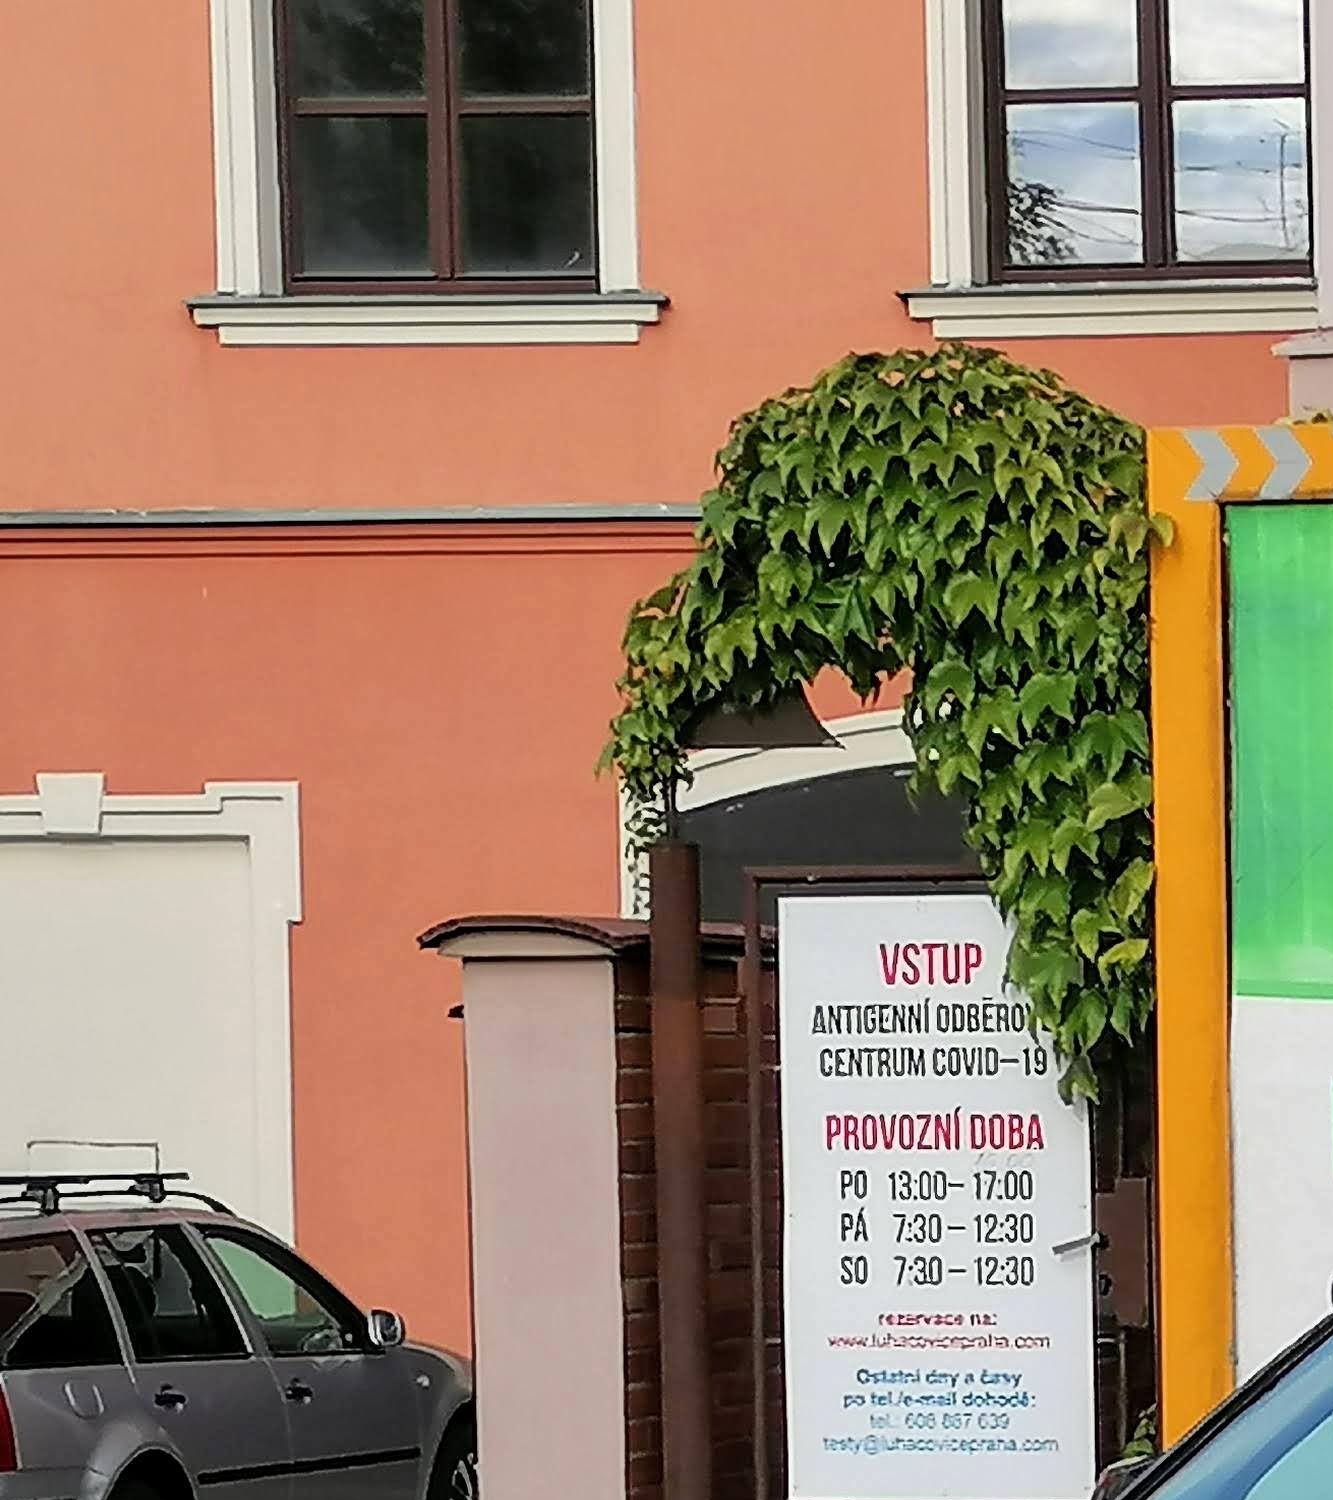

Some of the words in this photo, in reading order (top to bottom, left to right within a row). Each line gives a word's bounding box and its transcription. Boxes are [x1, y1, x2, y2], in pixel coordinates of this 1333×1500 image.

[879, 943, 983, 985] VSTUP
[812, 998, 931, 1034] ANTIGENNÍ
[936, 997, 1053, 1033] ODBĚRO
[820, 1048, 926, 1076] CENTRUM
[932, 1047, 1048, 1077] COVID-19
[826, 1106, 962, 1150] PROVOZNÍ
[970, 1114, 1045, 1150] DOBA
[840, 1170, 868, 1200] PO
[888, 1170, 947, 1200] 13:00
[974, 1170, 1034, 1200] 17:00
[840, 1207, 869, 1242] PÁ
[893, 1213, 942, 1243] 7:30
[974, 1213, 1034, 1243] 12:30
[840, 1256, 868, 1285] SO
[893, 1256, 943, 1286] 7:30
[974, 1256, 1034, 1286] 12:30
[879, 1313, 964, 1326] rezervace
[971, 1313, 997, 1326] na:
[856, 1368, 920, 1385] Ostatní
[925, 1369, 960, 1388] dny
[964, 1373, 975, 1385] a
[980, 1368, 1023, 1388] časy
[843, 1394, 866, 1408] po
[962, 1391, 1036, 1408] dohodě:
